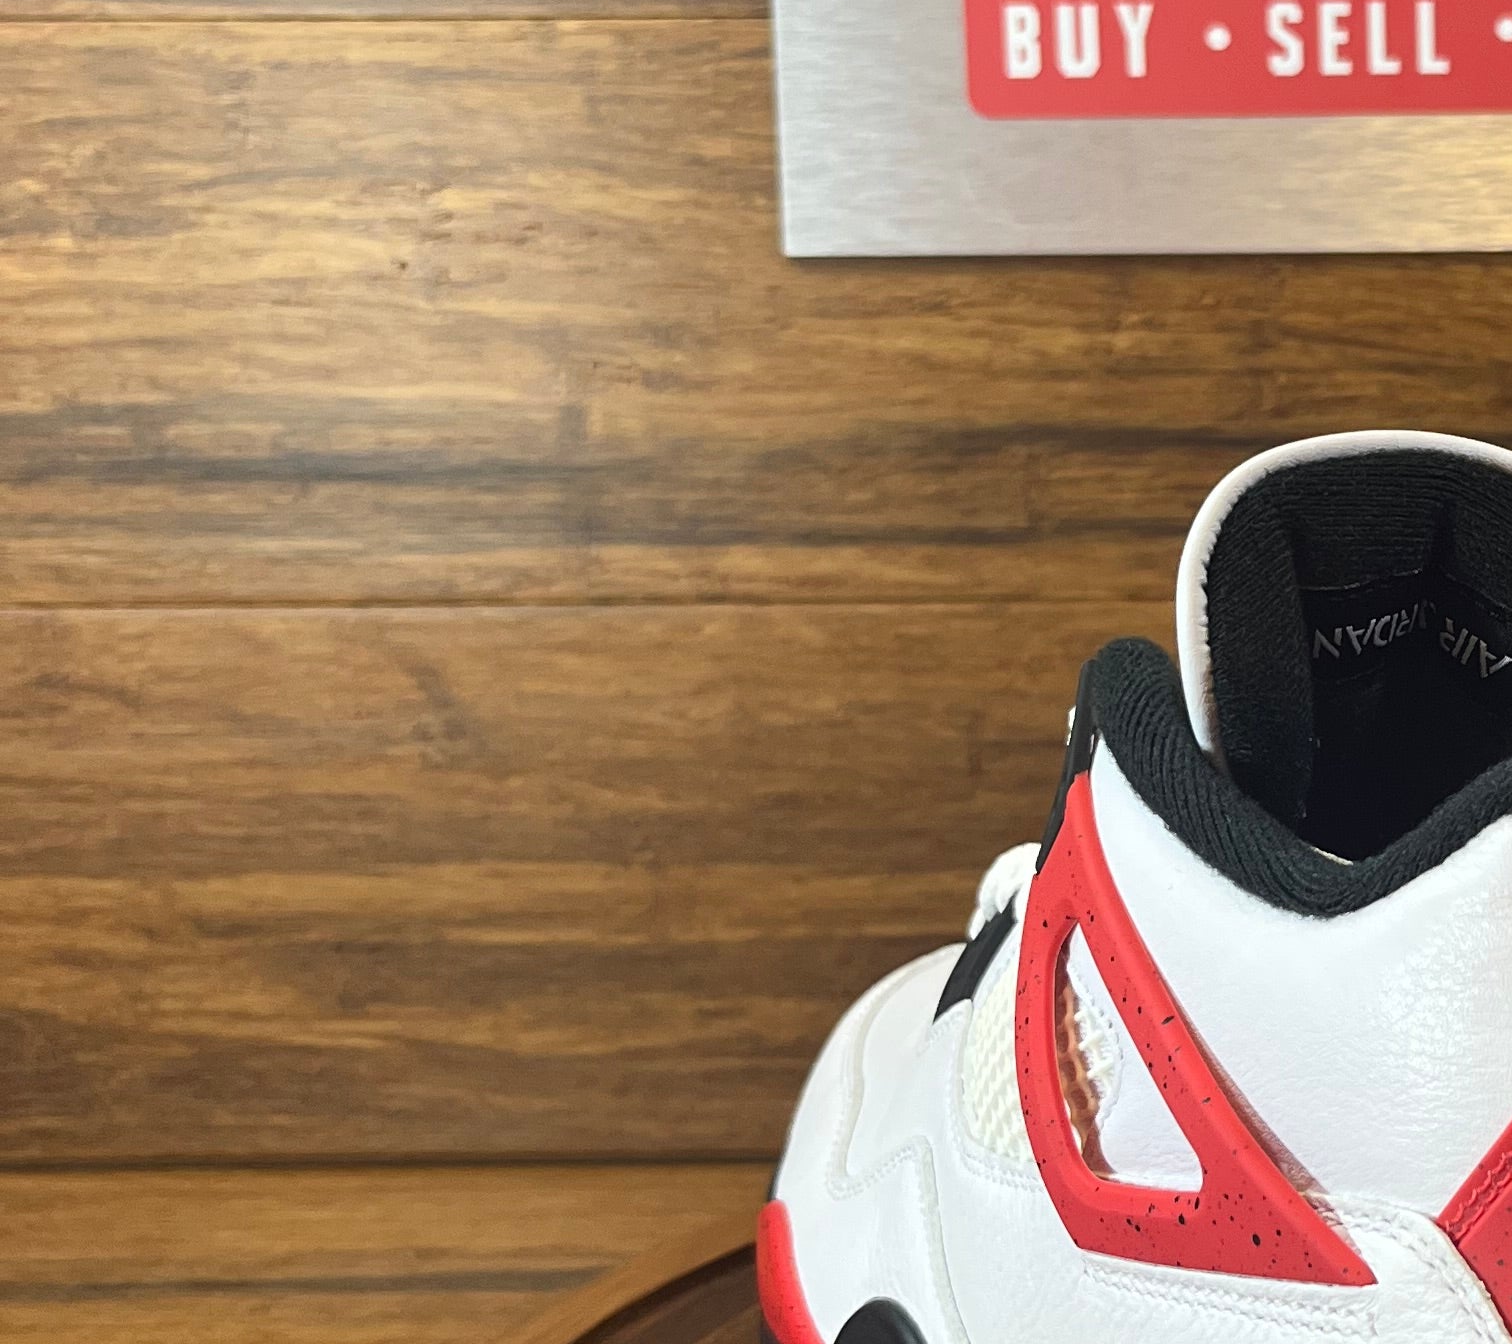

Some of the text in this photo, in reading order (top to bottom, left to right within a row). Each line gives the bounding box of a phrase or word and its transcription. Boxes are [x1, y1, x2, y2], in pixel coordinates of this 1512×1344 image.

[1005, 1, 1156, 79] BUY
[1268, 0, 1452, 76] SELL
[1312, 599, 1512, 680] AIR JRDAN
